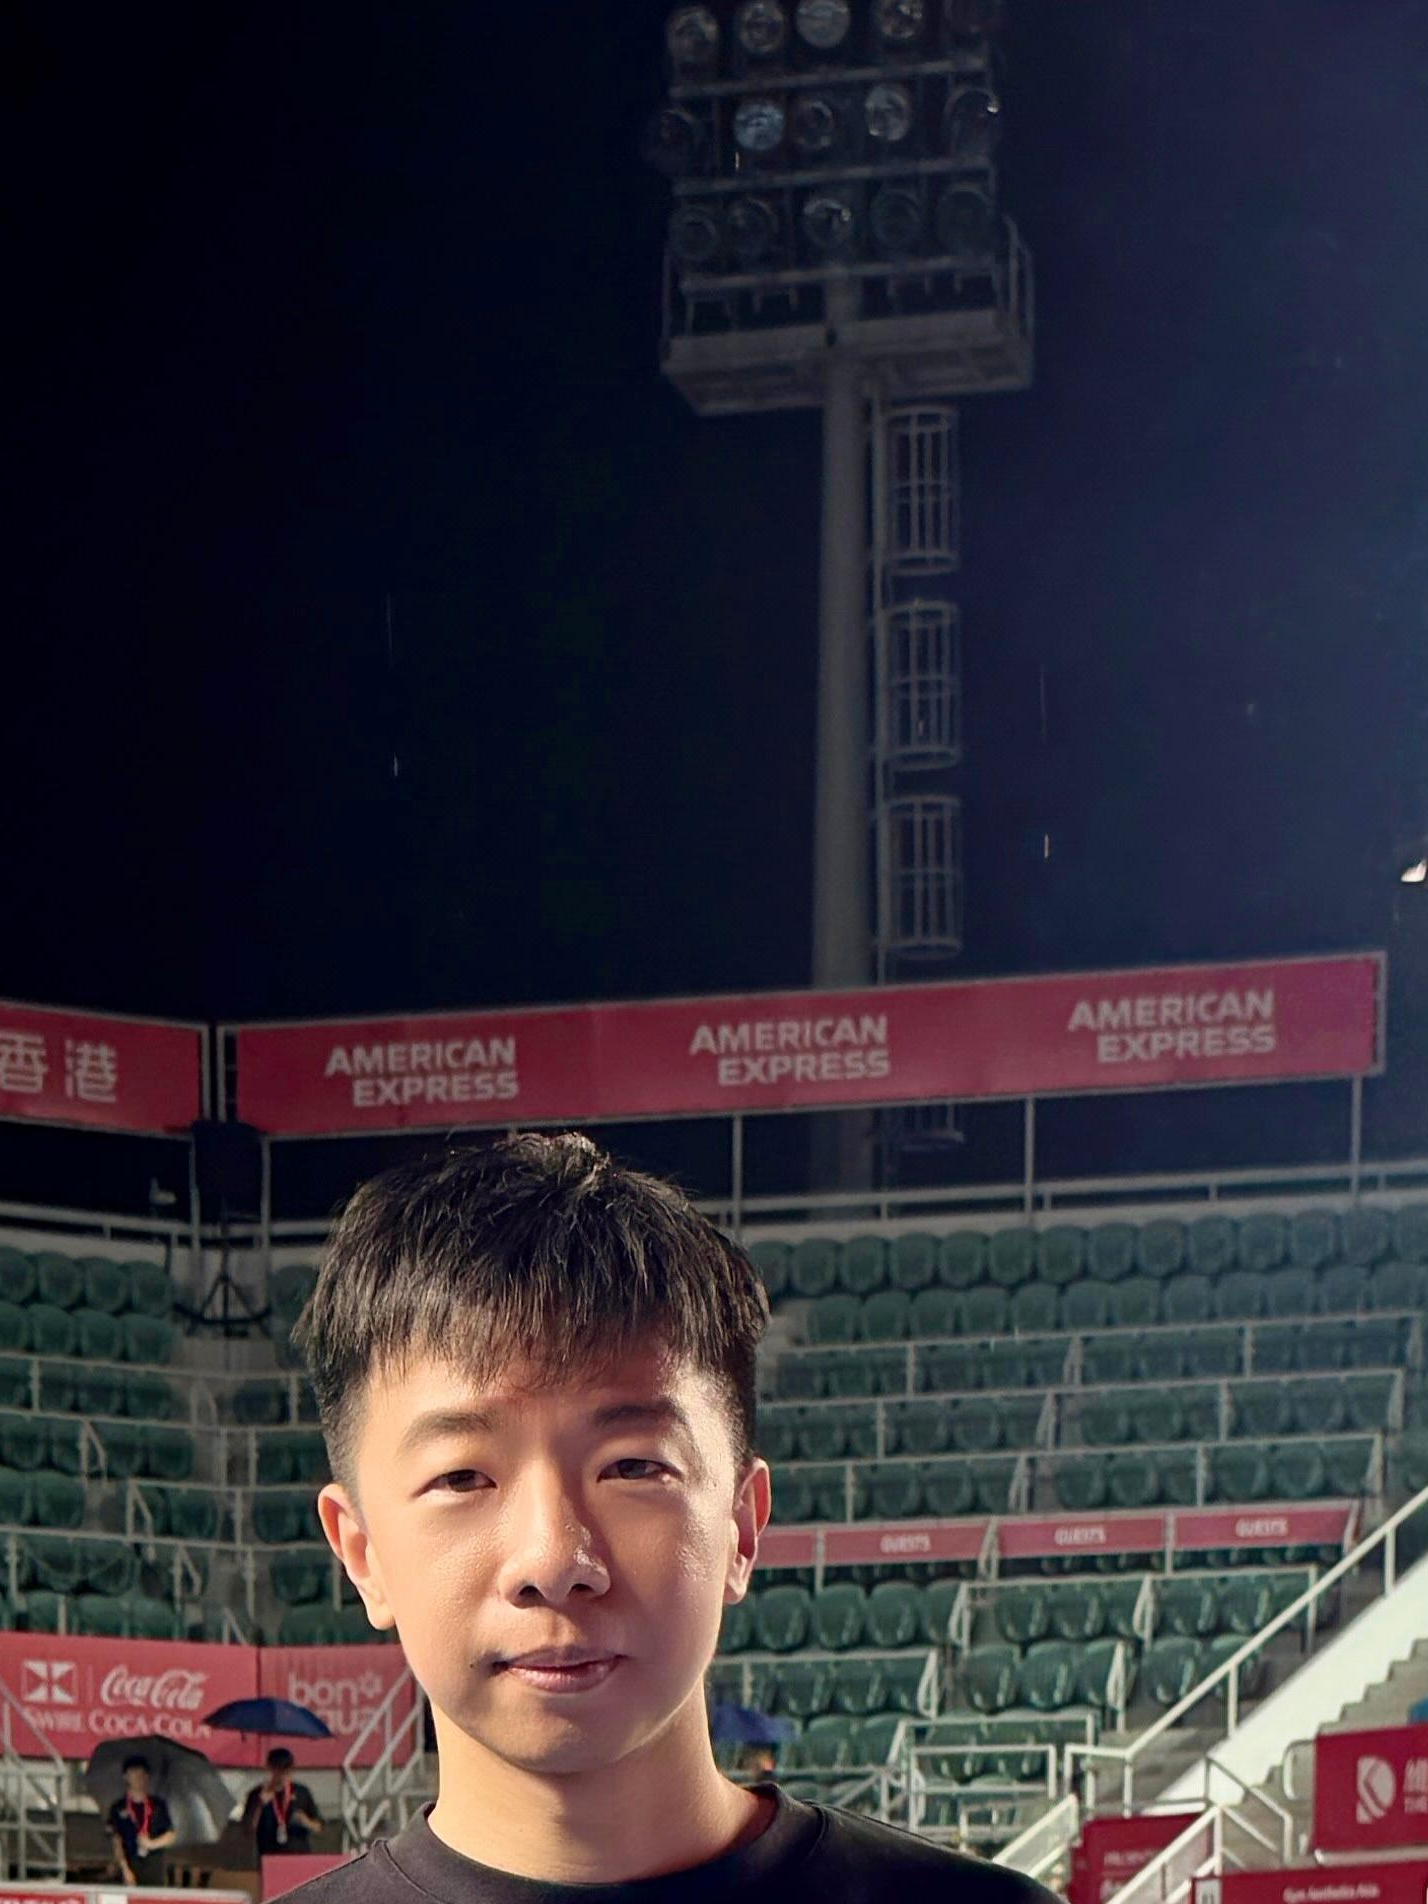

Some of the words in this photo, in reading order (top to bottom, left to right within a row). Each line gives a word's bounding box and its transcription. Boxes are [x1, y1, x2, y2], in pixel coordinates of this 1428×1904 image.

[1067, 989, 1275, 1032] AMERICAN
[689, 1014, 889, 1057] AMERICAN
[1096, 1024, 1277, 1064] EXPRESS
[324, 1036, 516, 1078] AMERICAN
[717, 1048, 893, 1087] EXPRESS
[351, 1070, 520, 1108] EXPRESS
